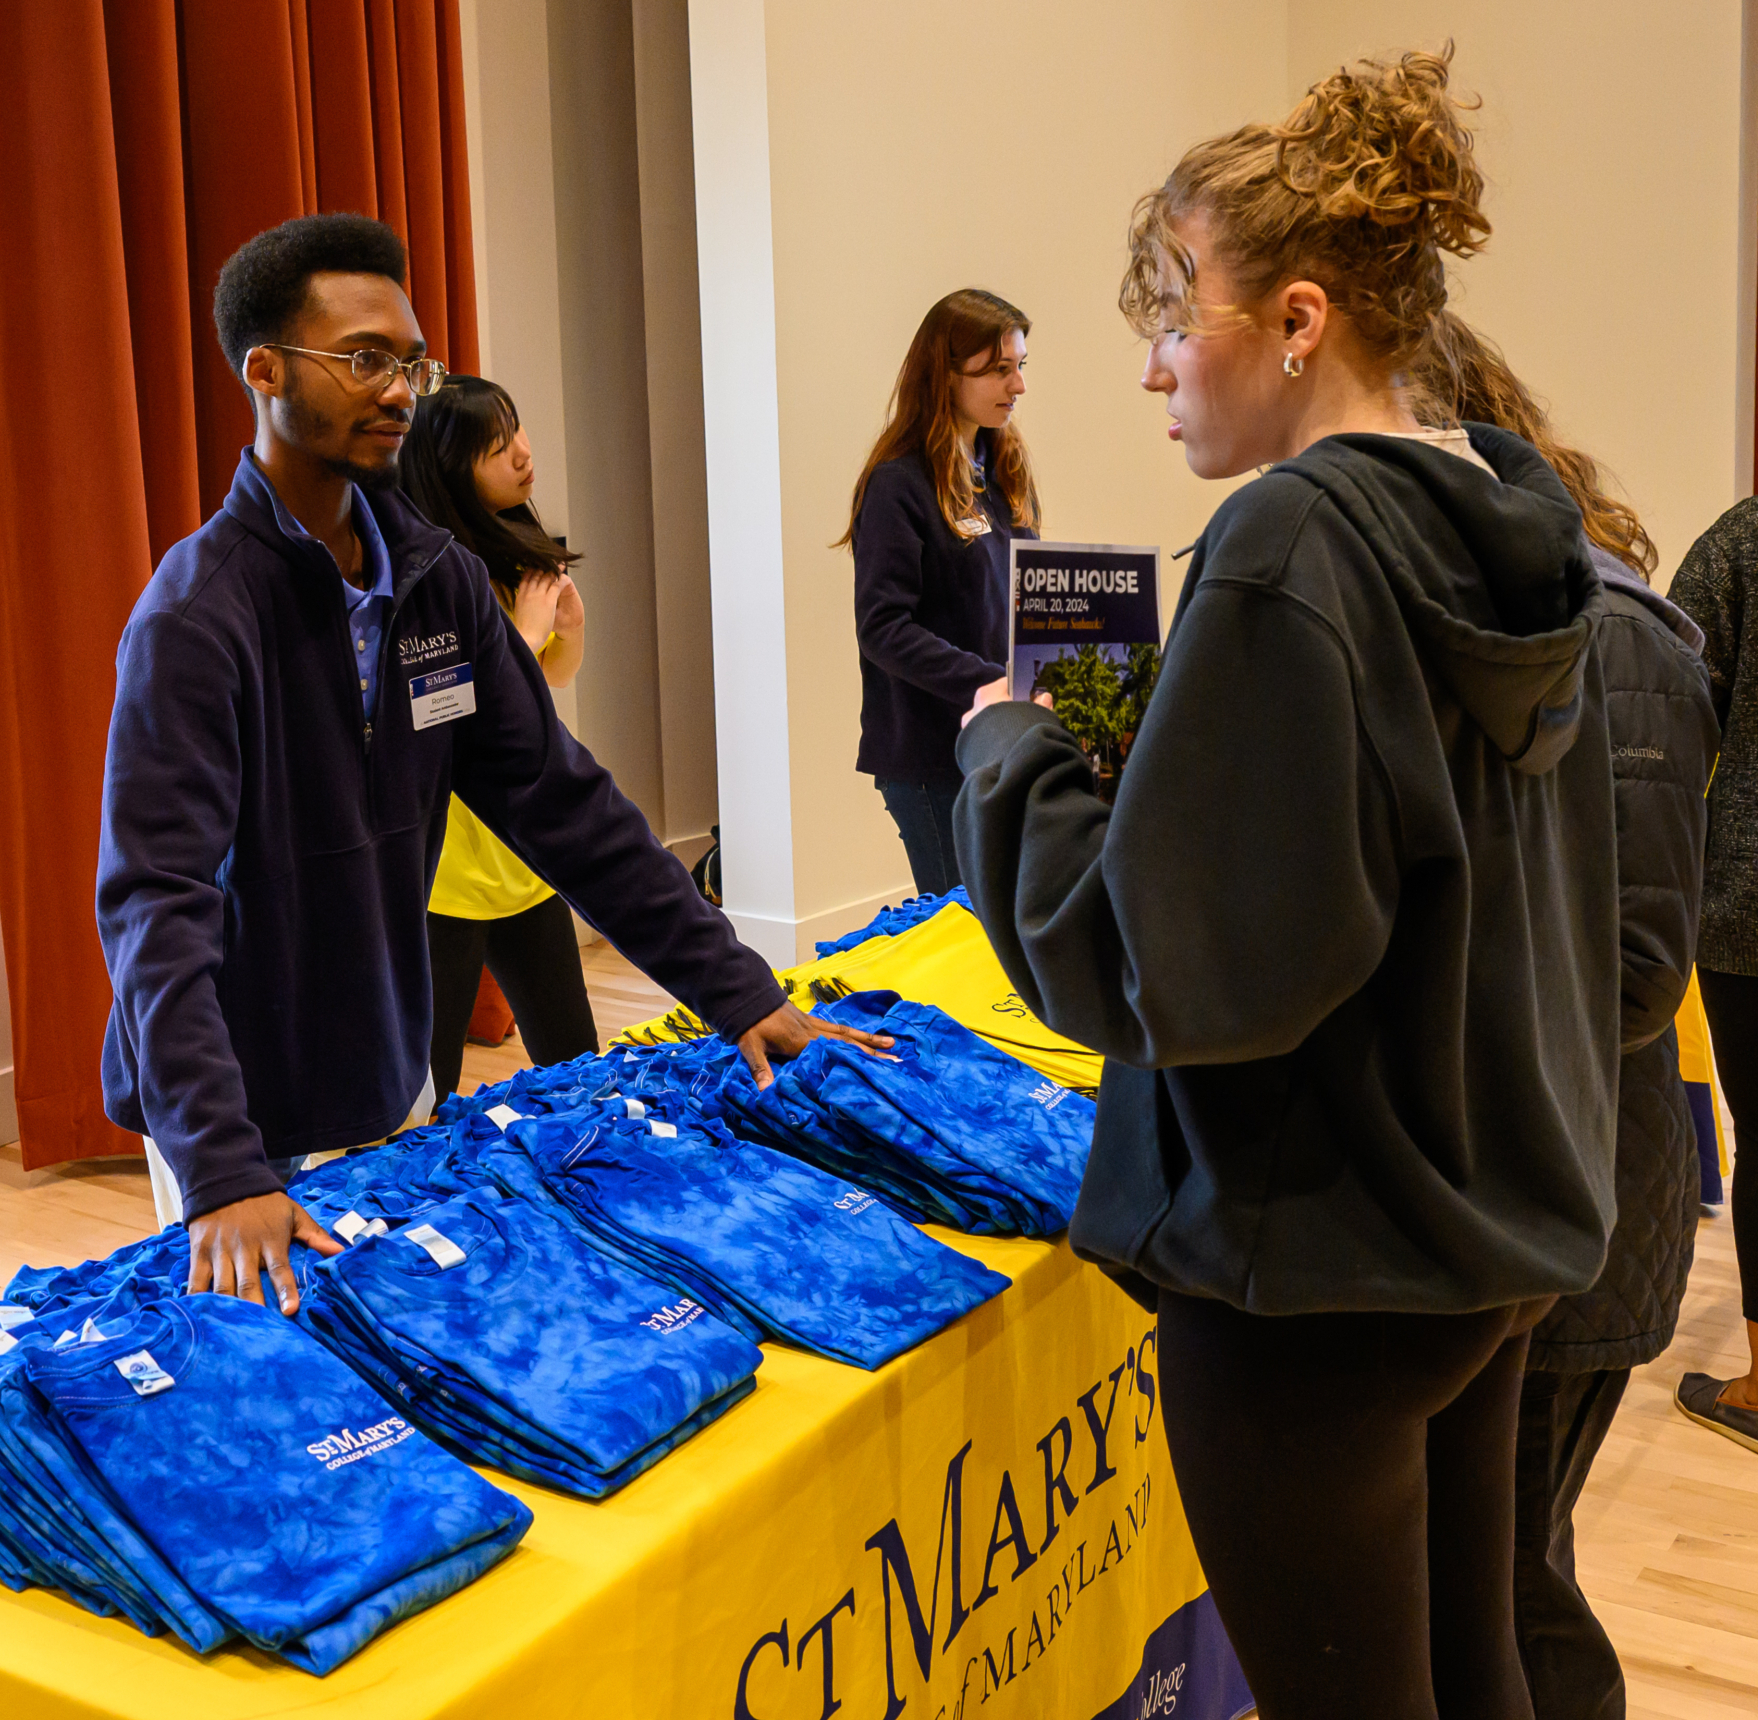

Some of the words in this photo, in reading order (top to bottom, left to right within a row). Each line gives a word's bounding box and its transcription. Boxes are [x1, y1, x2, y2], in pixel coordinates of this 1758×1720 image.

[1024, 567, 1070, 593] OPEN
[1074, 569, 1139, 594] HOUSE
[1023, 598, 1048, 612] APRIL
[1050, 598, 1064, 614] 20,
[1065, 598, 1090, 612] 2024
[425, 645, 458, 659] MARYLAND
[431, 694, 454, 705] Romeo
[1609, 744, 1664, 760] Columbia
[651, 1298, 698, 1327] MAR
[326, 1449, 366, 1471] COLLEGE
[370, 1426, 416, 1454] MARYLAND
[865, 1325, 1157, 1720] MARY'S
[980, 1472, 1151, 1705] MARYLAND
